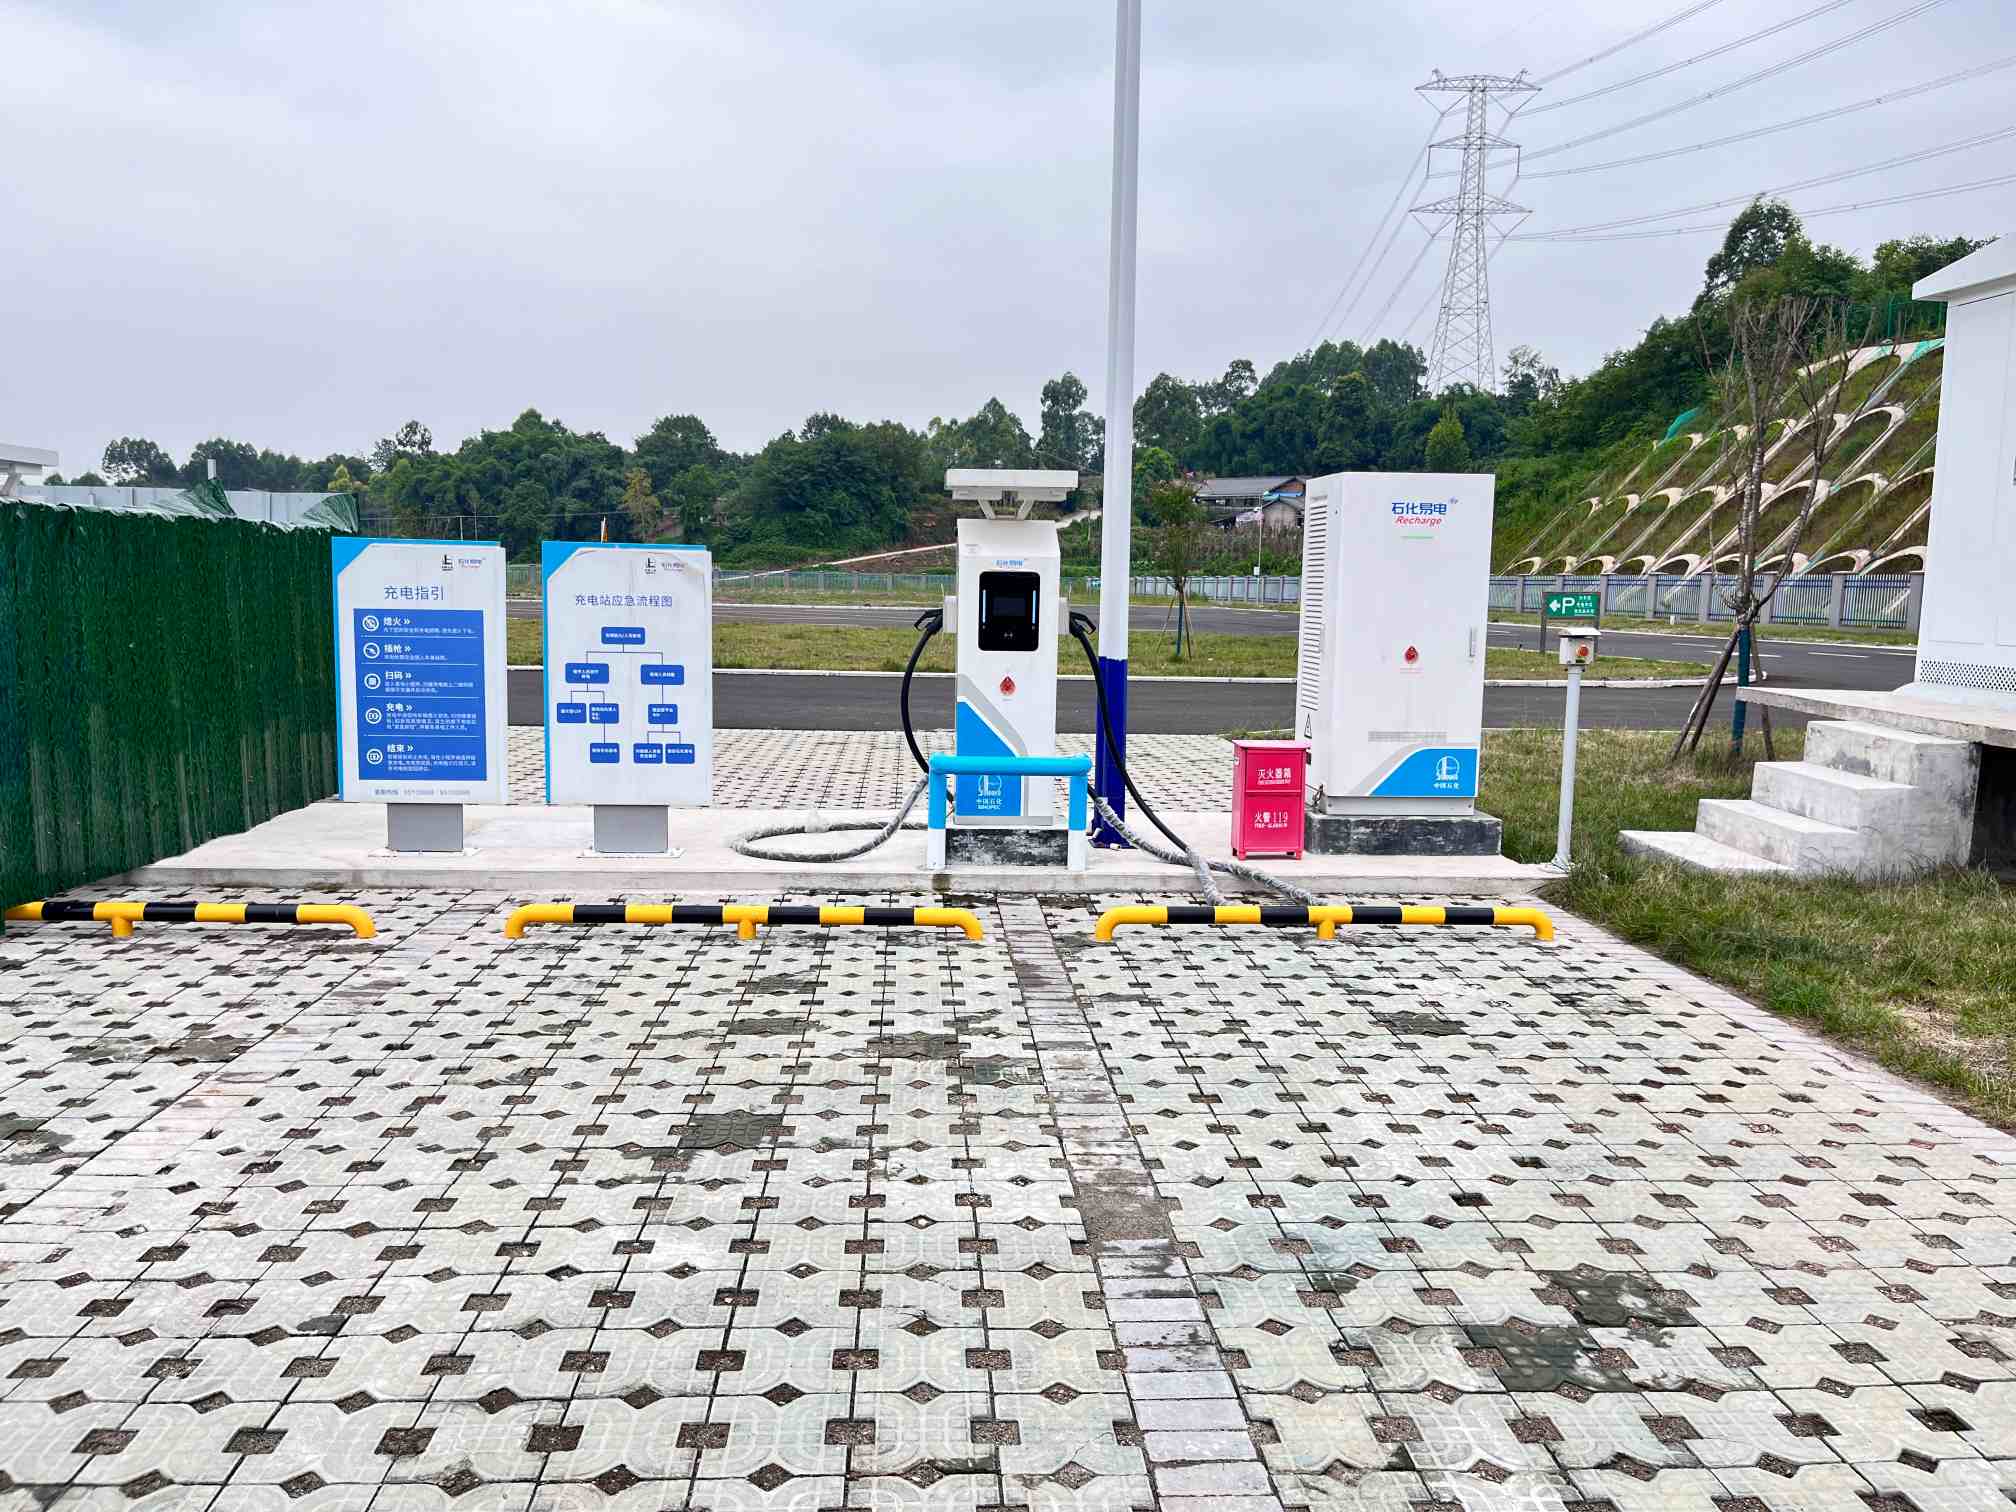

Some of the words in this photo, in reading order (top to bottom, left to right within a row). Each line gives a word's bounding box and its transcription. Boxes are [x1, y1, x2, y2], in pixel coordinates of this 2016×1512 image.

[1391, 502, 1447, 515] 石化易电
[1395, 516, 1442, 527] Recharge
[384, 586, 444, 601] 充电指引
[575, 594, 673, 608] 充电站应急流程图
[1561, 597, 1576, 614] P
[383, 617, 401, 626] 熄火
[384, 644, 402, 653] 插枪
[385, 671, 403, 680] 扫码
[385, 703, 404, 712] 充电
[387, 744, 405, 753] 结束
[1256, 767, 1291, 779] 灭火器箱
